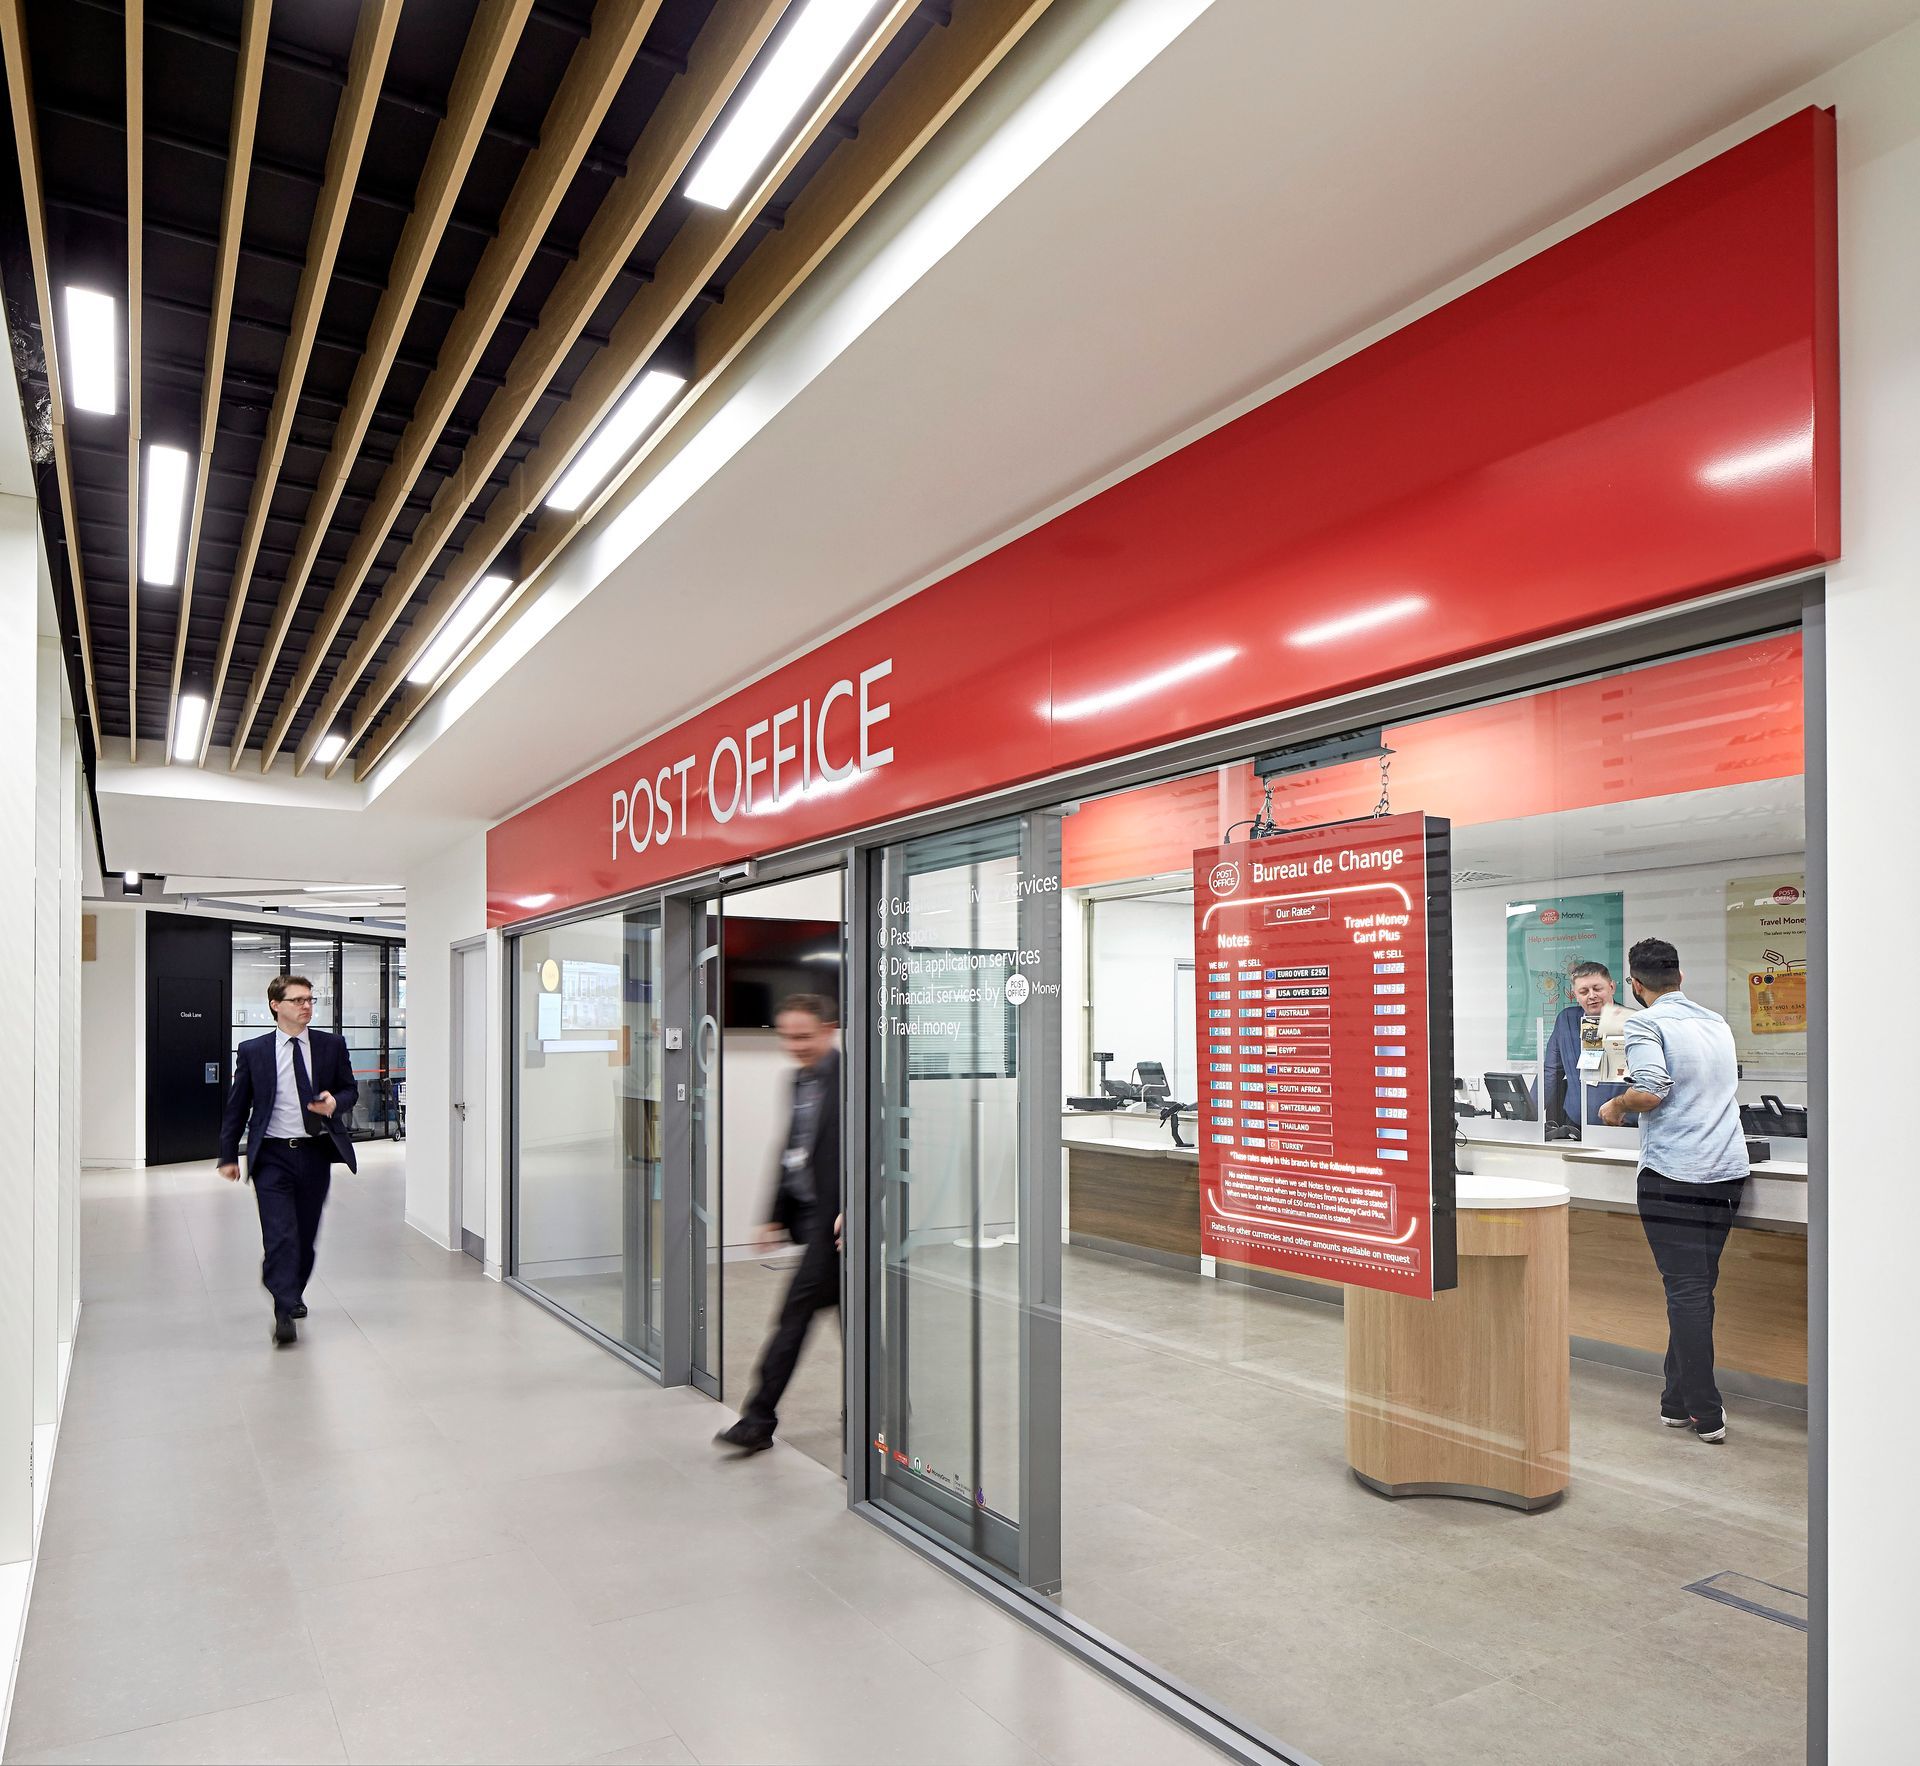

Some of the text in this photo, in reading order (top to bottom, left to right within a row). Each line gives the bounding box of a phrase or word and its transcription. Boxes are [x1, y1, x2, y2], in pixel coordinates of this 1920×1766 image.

[612, 657, 894, 861] POST OFFICE
[1253, 848, 1404, 883] Bureau de Change
[1216, 869, 1233, 879] POST
[1212, 877, 1236, 888] OFFICE
[1276, 907, 1290, 919] Our
[1561, 911, 1584, 920] Money
[1344, 913, 1409, 928] Travel Money
[1760, 917, 1782, 926] Travel
[1217, 934, 1250, 948] Notes
[1353, 929, 1401, 944] Card Plus
[1528, 936, 1541, 944] Help
[1373, 950, 1404, 959] WE SELL
[891, 948, 1041, 982] Digital application services
[1218, 961, 1228, 969] BUY
[1238, 959, 1261, 968] WE SELL
[1277, 968, 1327, 978] EURO OVER £250
[1010, 980, 1024, 988] POST
[891, 980, 1000, 1009] Financial services by
[1007, 988, 1027, 997] OFFICE
[1031, 981, 1061, 998] Money
[1278, 987, 1328, 997] USA OVER £250
[891, 1015, 961, 1041] Travel money
[1278, 1046, 1297, 1054] EGYPT
[1279, 1066, 1320, 1074] NEW ZEALAND
[1300, 1085, 1322, 1093] AFRICA
[1280, 1104, 1321, 1112] SWITZERLAND
[1280, 1122, 1310, 1131] THAILAND
[1281, 1142, 1304, 1150] TURKEY
[1280, 1157, 1290, 1165] this
[1291, 1158, 1309, 1167] branch
[1310, 1159, 1318, 1168] for
[1319, 1160, 1328, 1170] the
[1329, 1161, 1355, 1174] following
[1308, 1181, 1324, 1190] Notes
[1344, 1186, 1363, 1195] unless
[1297, 1189, 1307, 1199] buy
[1308, 1191, 1323, 1200] Notes
[1324, 1193, 1337, 1202] from
[1350, 1197, 1368, 1206] unless
[1293, 1198, 1303, 1207] £50
[1304, 1201, 1316, 1209] onto
[1320, 1203, 1336, 1212] Travel
[1337, 1206, 1356, 1216] Money
[1357, 1208, 1371, 1217] Card
[1211, 1221, 1411, 1264] Rates for other currencies and other amounts available on request
